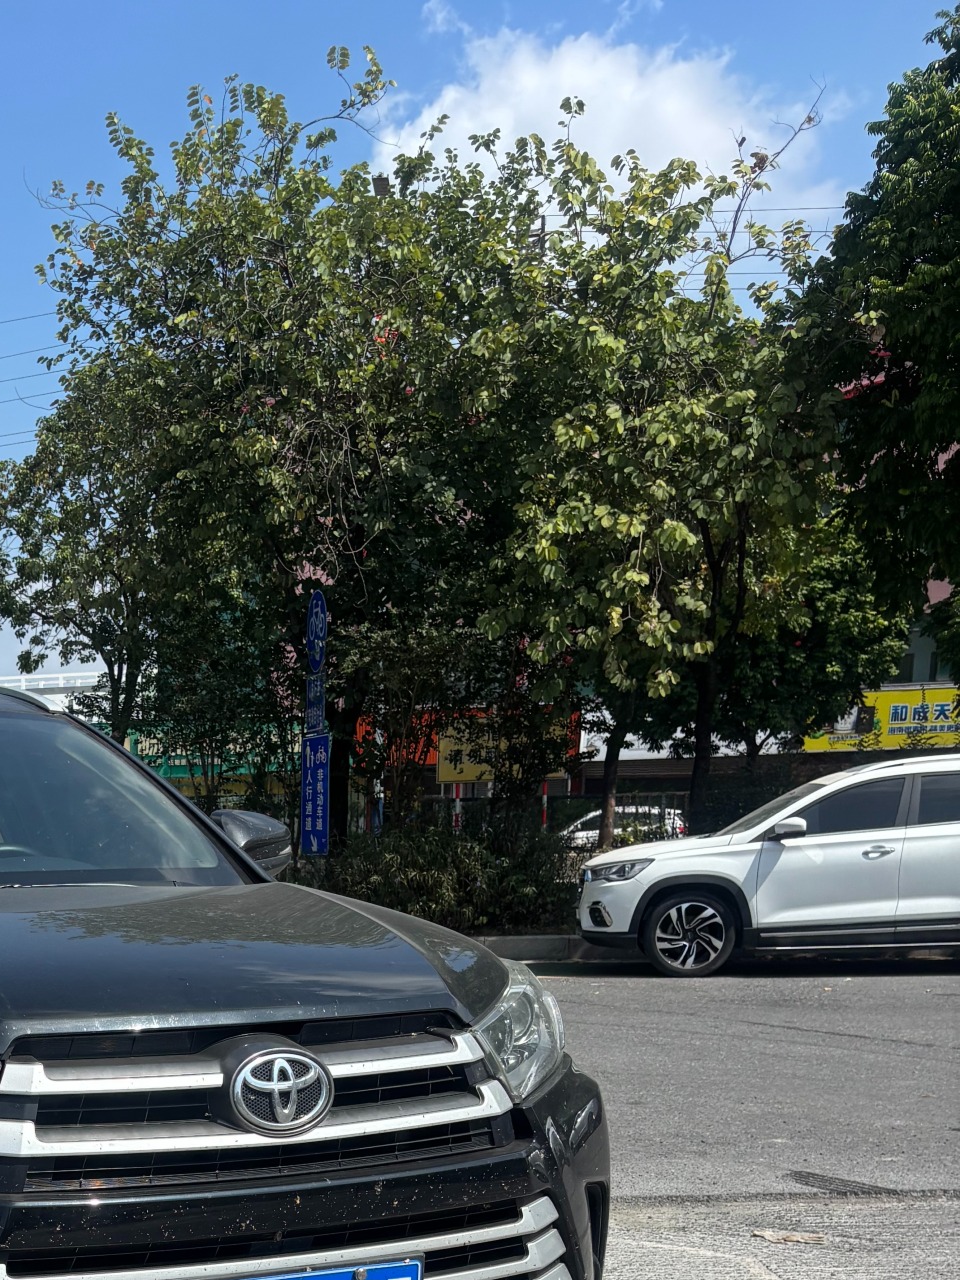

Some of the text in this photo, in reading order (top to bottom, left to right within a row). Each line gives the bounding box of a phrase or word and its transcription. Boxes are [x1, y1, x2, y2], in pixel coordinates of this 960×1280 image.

[316, 768, 324, 831] 非机动车道
